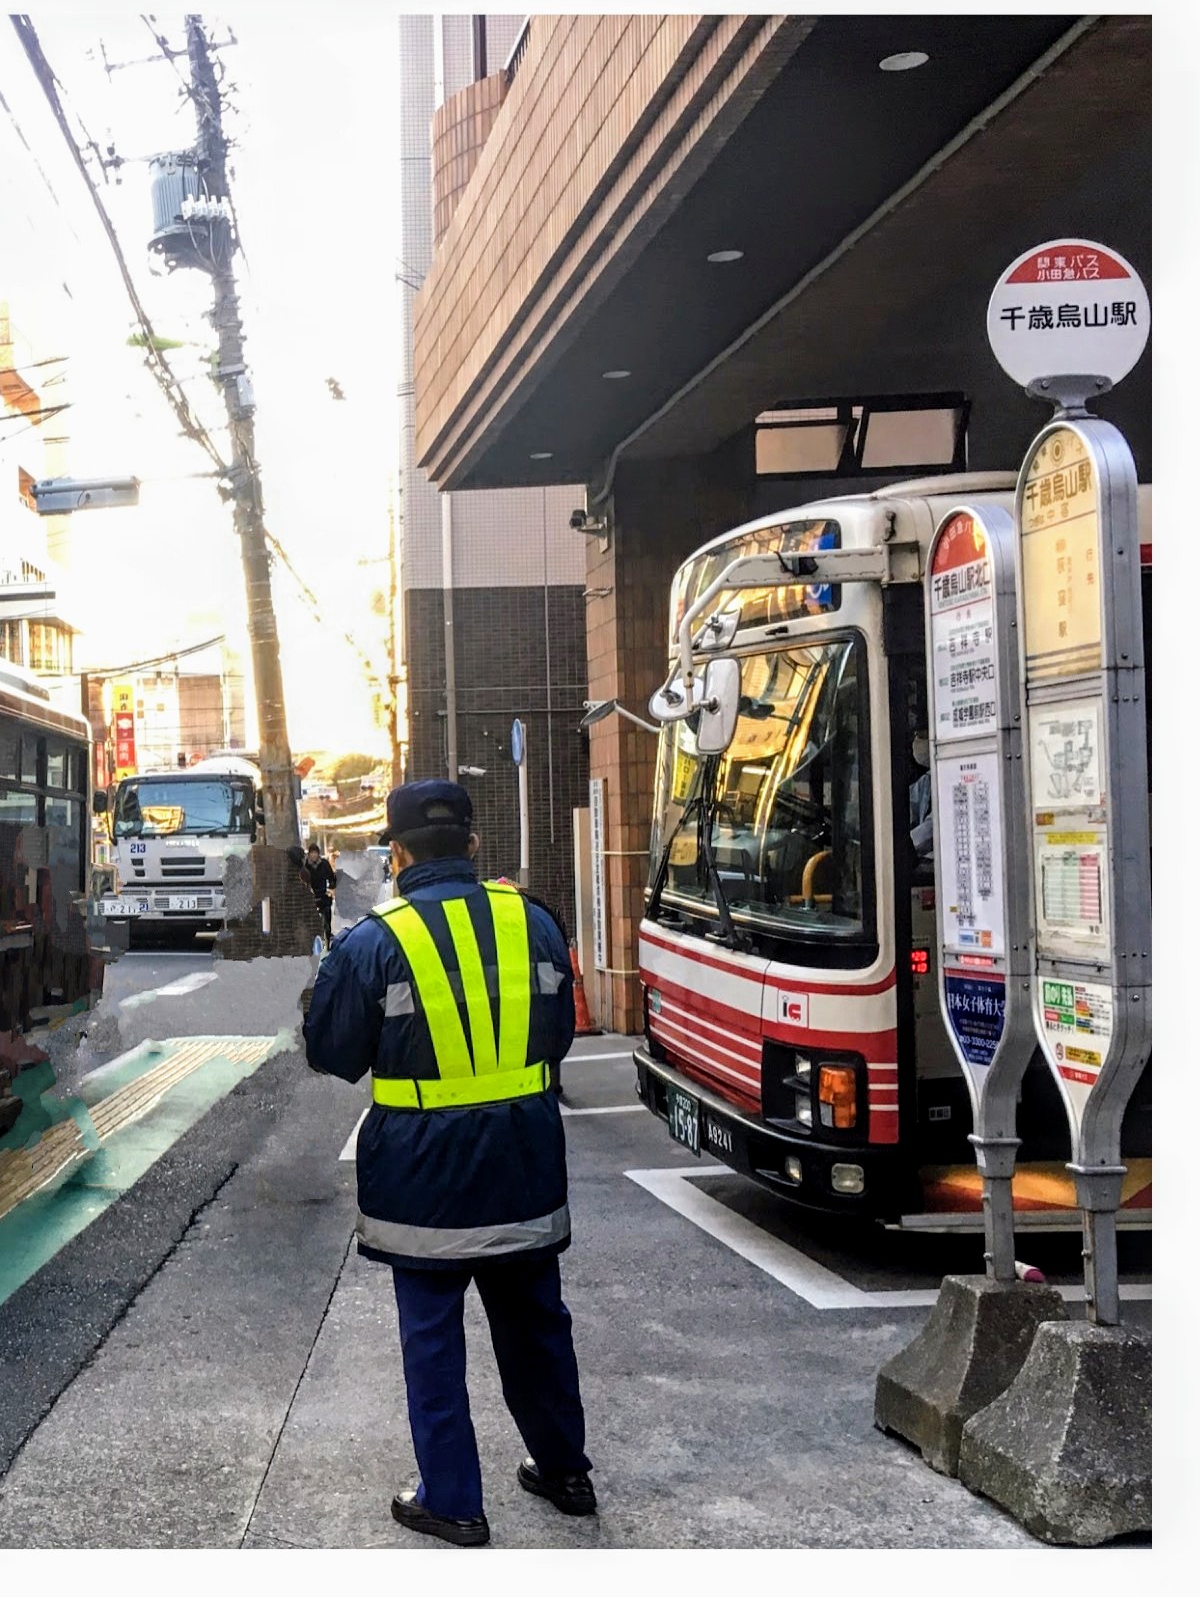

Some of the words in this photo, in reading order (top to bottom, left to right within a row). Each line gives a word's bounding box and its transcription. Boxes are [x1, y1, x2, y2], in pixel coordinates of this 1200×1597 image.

[1037, 266, 1100, 281] 小田急バス
[1000, 301, 1137, 331] 千歳烏山駅
[130, 843, 146, 853] 213
[947, 992, 1005, 1017] 日本女子体育大
[675, 1105, 698, 1150] 15-87
[709, 1123, 732, 1153] A9241
